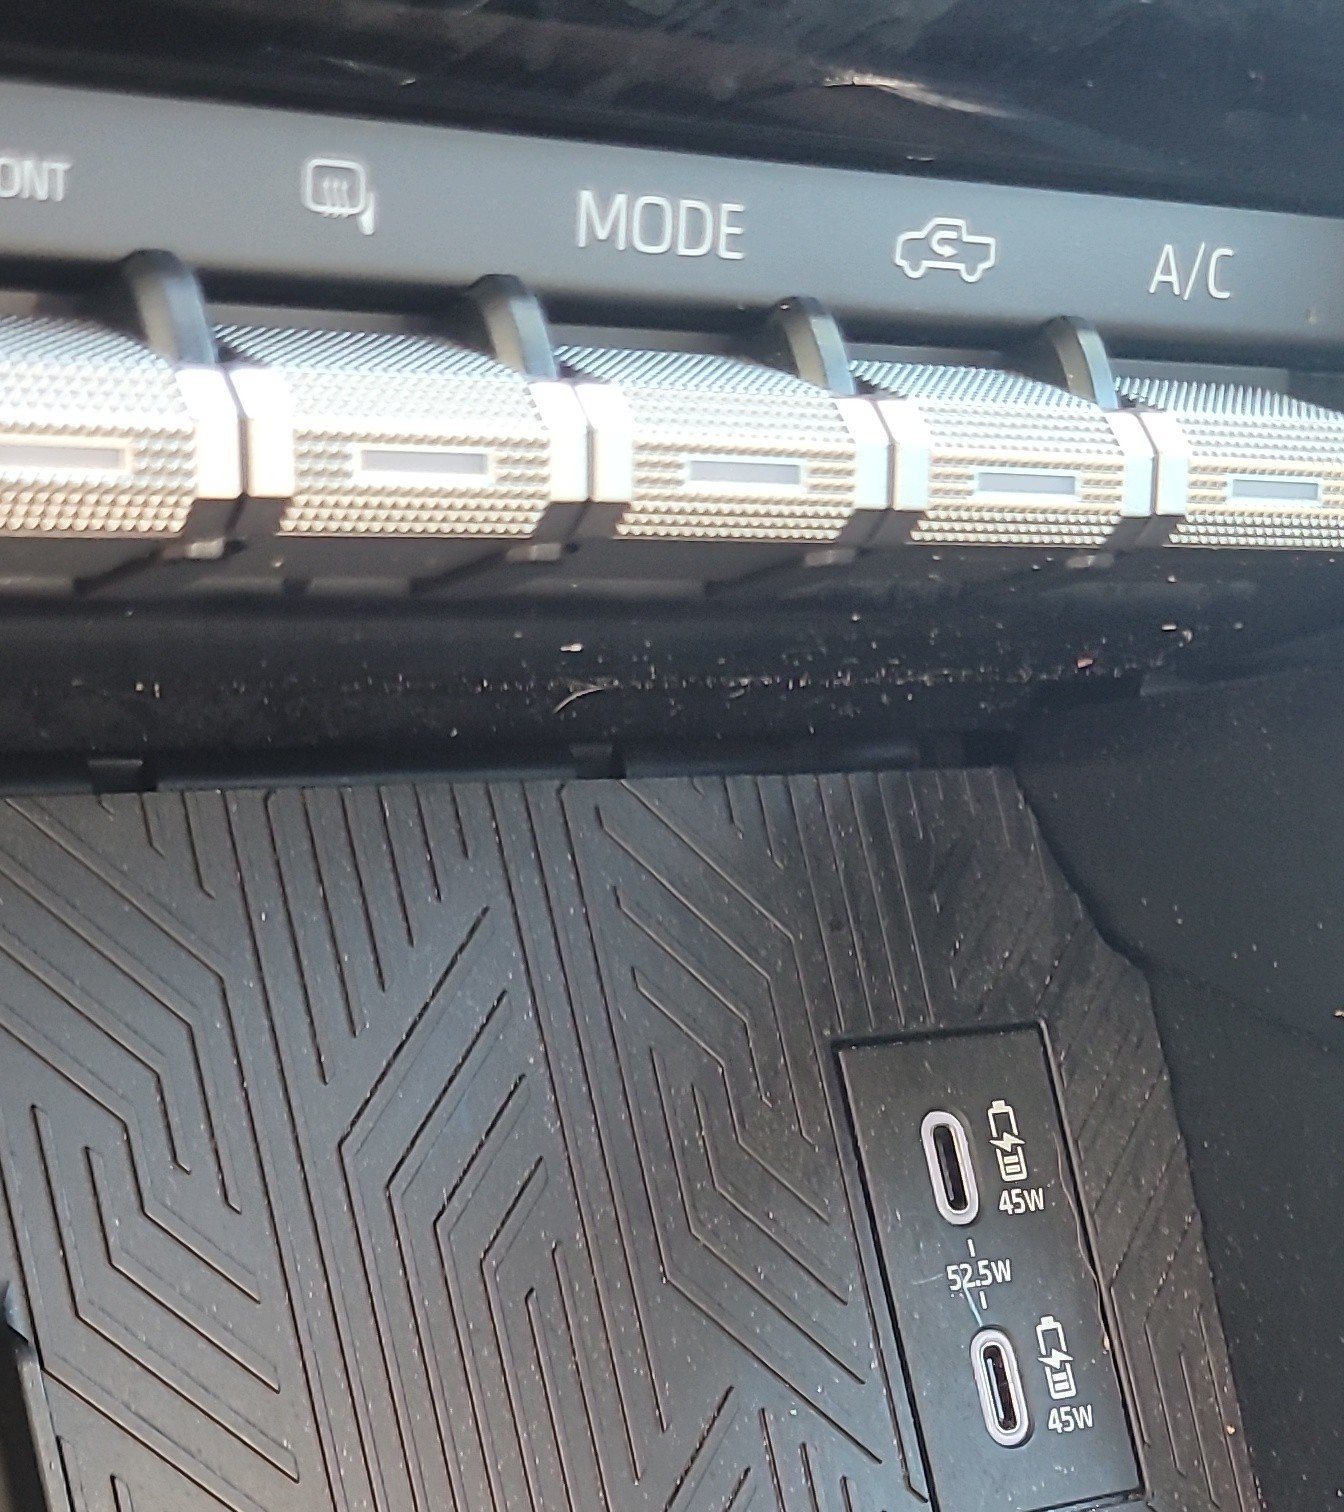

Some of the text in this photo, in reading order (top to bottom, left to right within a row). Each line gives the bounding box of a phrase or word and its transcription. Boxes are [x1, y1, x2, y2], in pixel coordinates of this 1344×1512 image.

[577, 189, 746, 260] MODE
[1148, 242, 1235, 300] A/C
[998, 1187, 1045, 1215] 45W
[946, 1259, 1011, 1291] 52.5W
[1048, 1404, 1093, 1434] 45W
